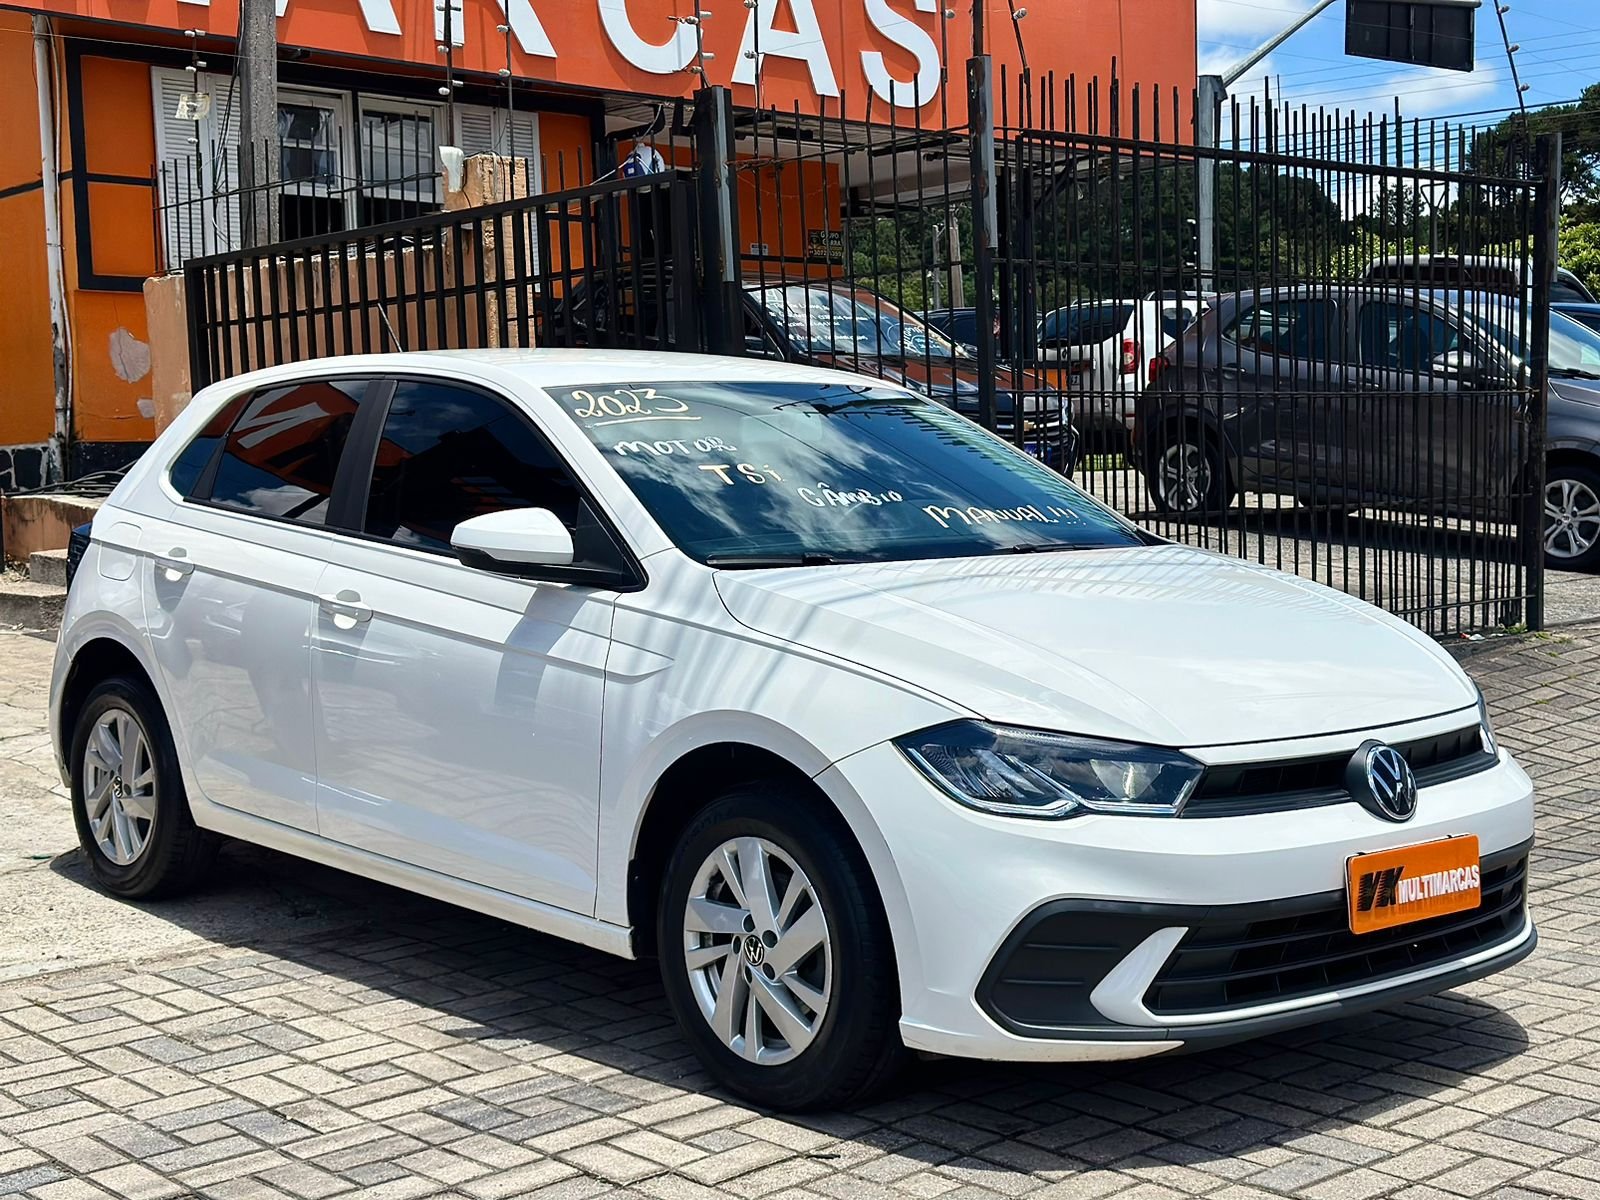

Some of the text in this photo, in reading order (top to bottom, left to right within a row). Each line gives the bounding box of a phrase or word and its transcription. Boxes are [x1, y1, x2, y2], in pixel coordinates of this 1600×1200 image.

[571, 388, 689, 418] 2023
[1357, 864, 1480, 912] VK MULTIMARCAS
